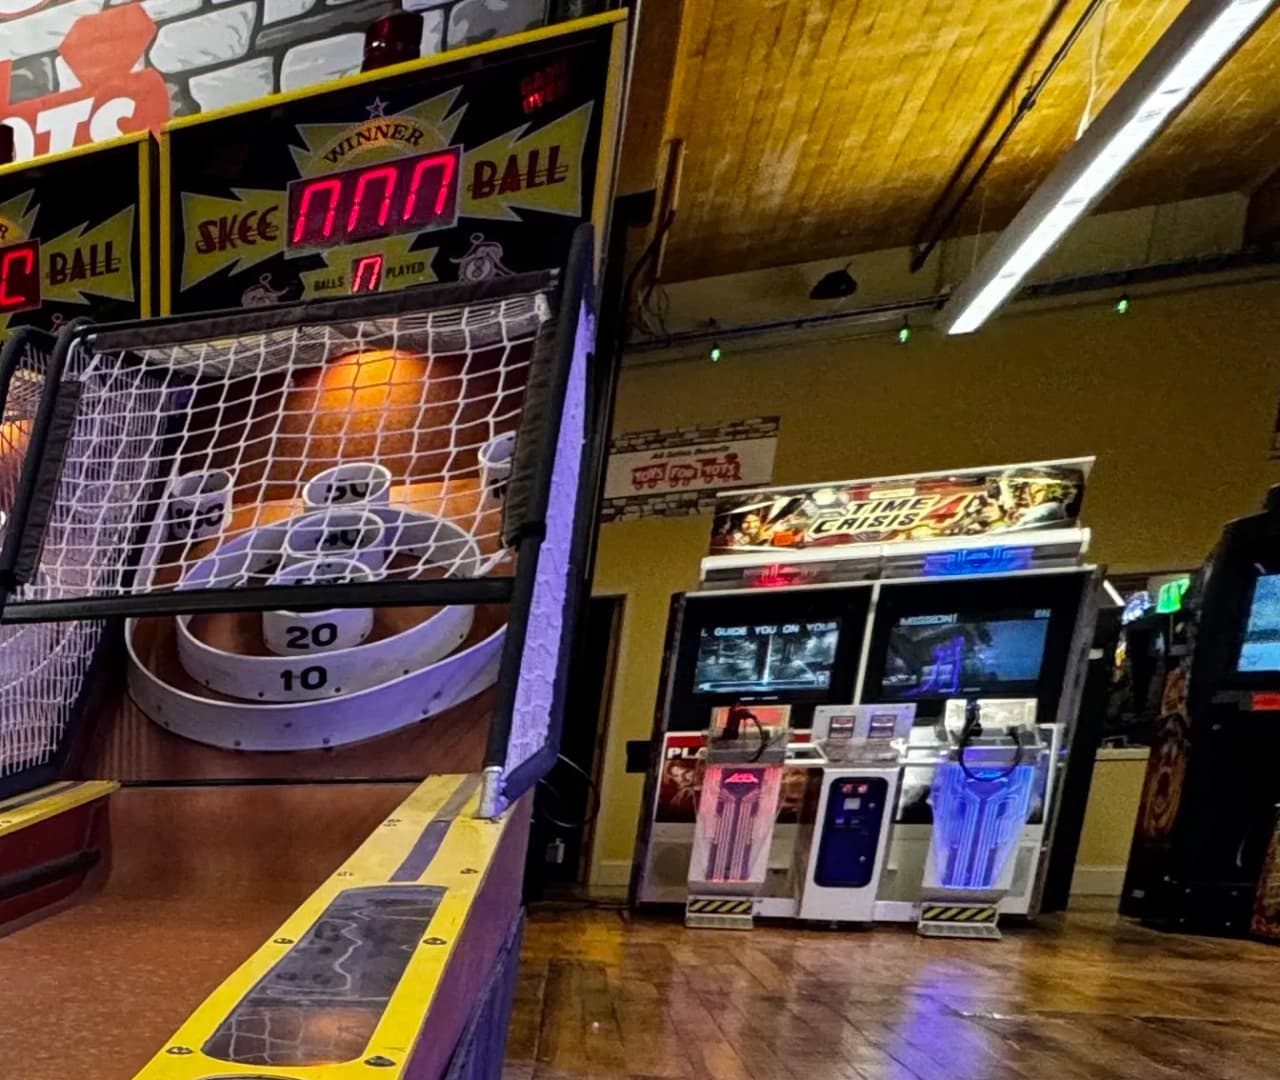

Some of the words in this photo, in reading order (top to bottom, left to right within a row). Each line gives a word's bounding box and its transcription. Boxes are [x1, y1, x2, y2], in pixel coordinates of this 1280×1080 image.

[321, 123, 425, 167] WINNER
[195, 205, 281, 255] SKEE
[467, 145, 569, 200] BALL
[47, 240, 121, 287] BALL
[384, 261, 425, 281] PLAYED
[851, 497, 932, 516] TIME
[919, 494, 967, 525] 4
[813, 511, 921, 534] CRISIS
[286, 623, 338, 650] 20
[714, 626, 747, 636] GUIDE
[755, 625, 777, 635] YOU
[782, 624, 800, 634] ON
[806, 622, 837, 632] YOUR
[279, 666, 328, 692] 10
